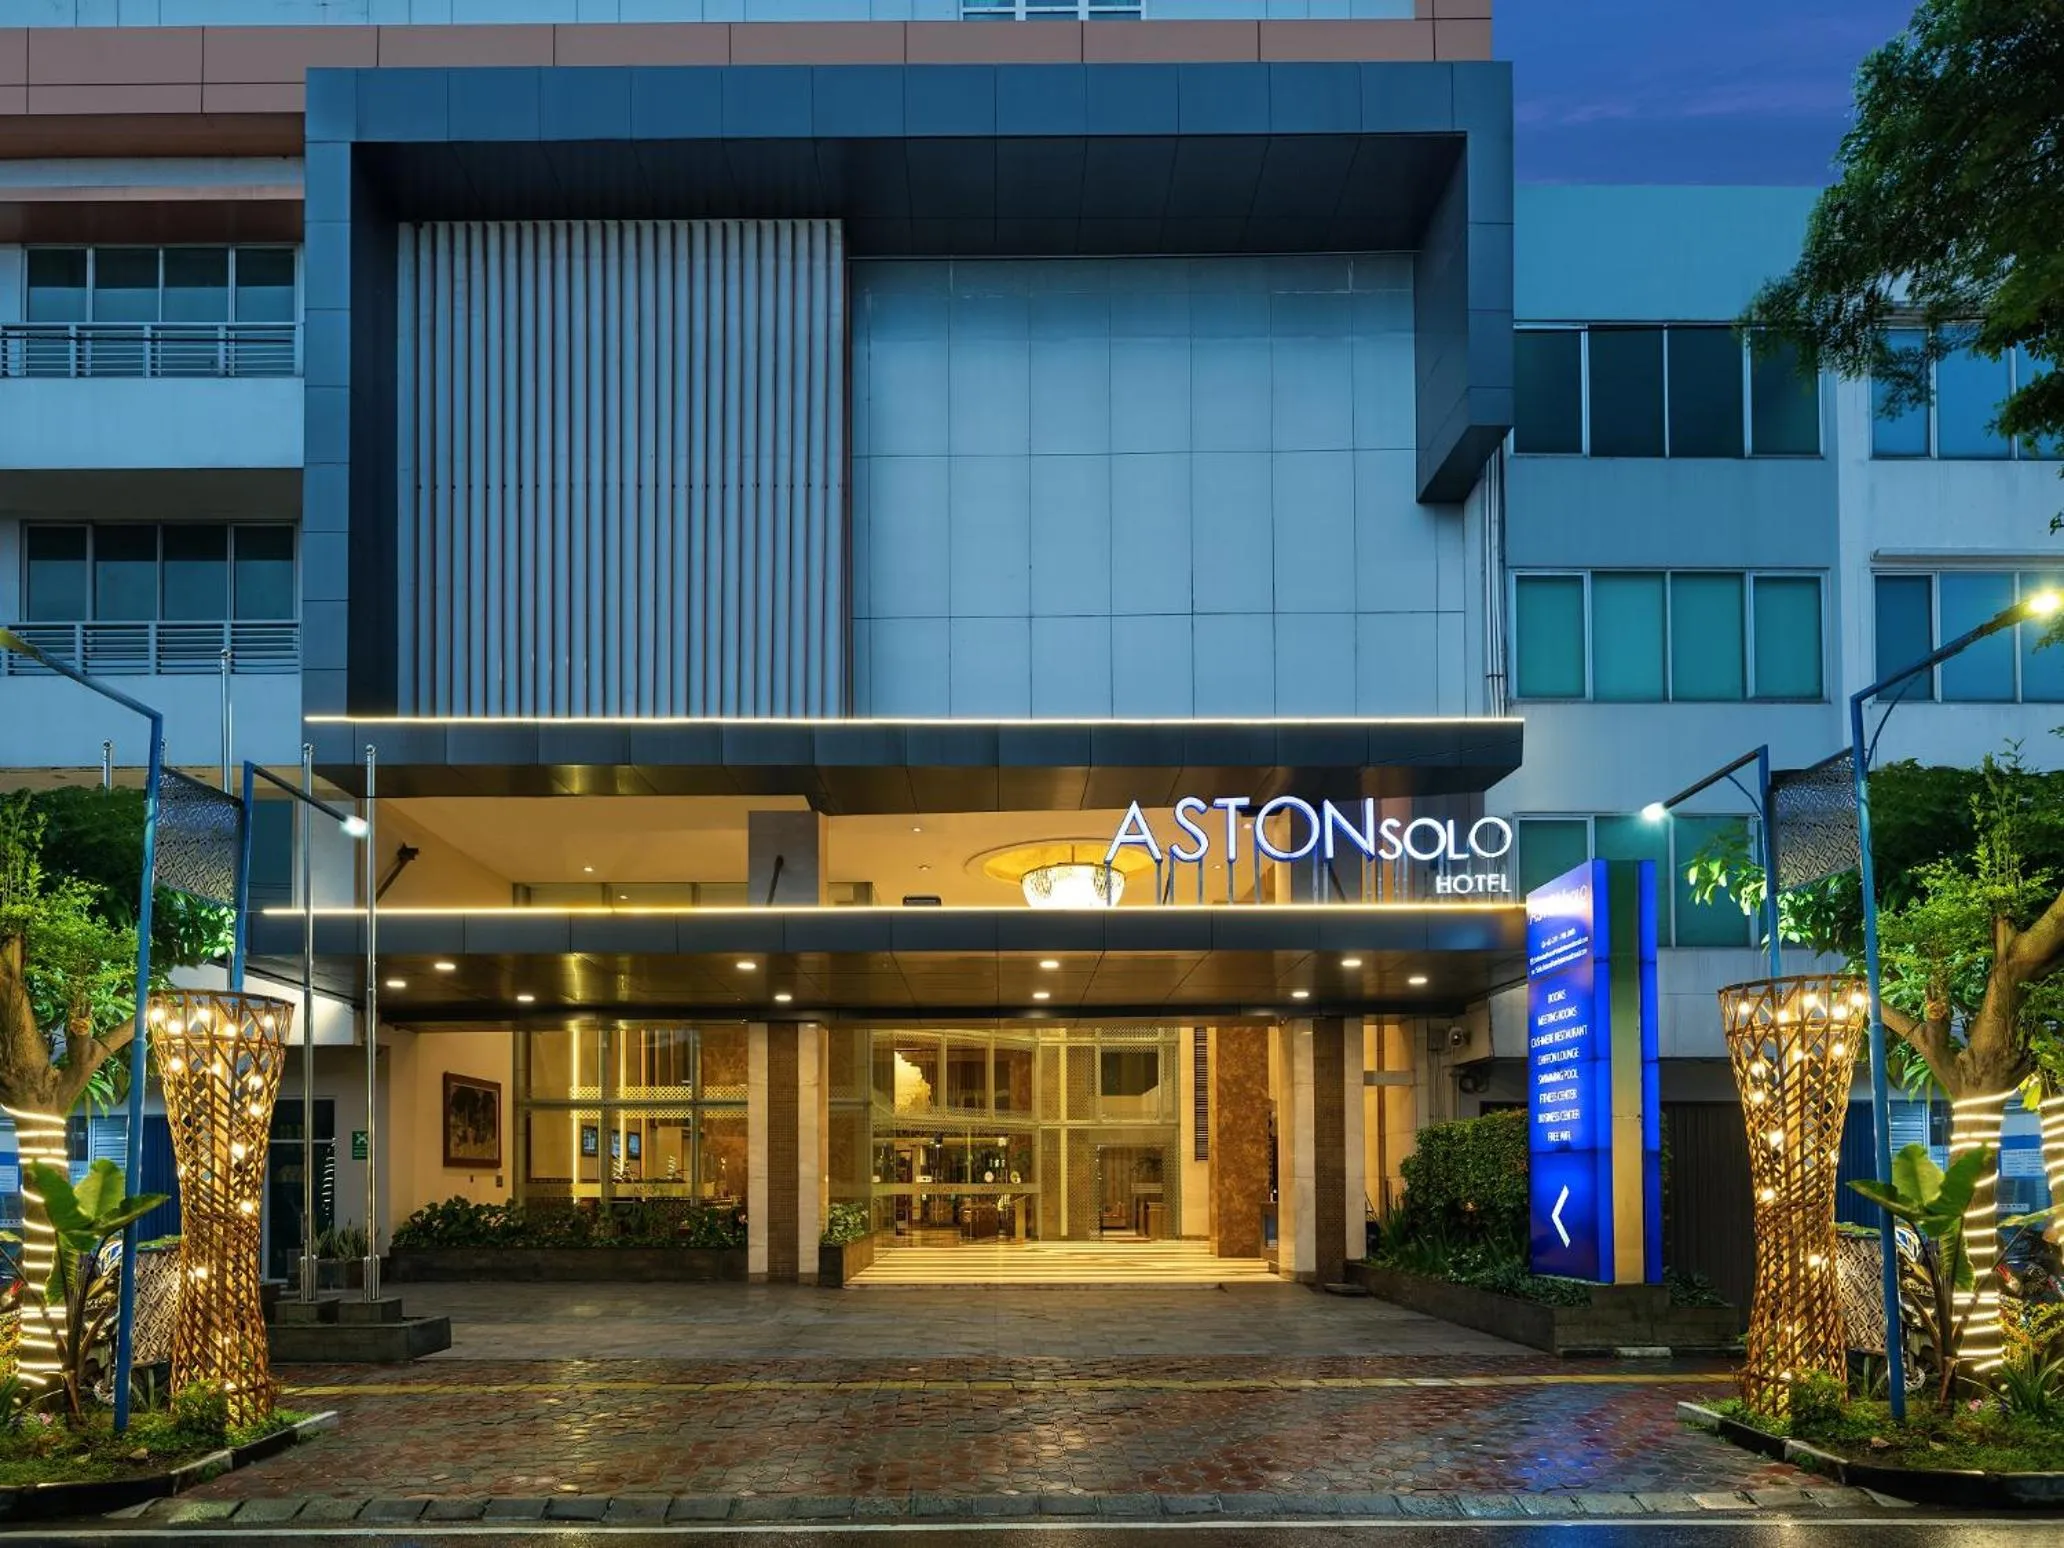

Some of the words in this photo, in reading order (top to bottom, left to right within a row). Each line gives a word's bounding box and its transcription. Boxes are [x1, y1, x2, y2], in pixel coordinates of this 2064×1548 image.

[1104, 796, 1375, 862] ASTON
[1378, 816, 1512, 861] SOLO
[1435, 873, 1512, 894] HOTEL
[1547, 989, 1566, 1003] ROOMS
[1538, 1011, 1558, 1025] MEETING
[1558, 1006, 1577, 1020] ROOMS
[1554, 1025, 1588, 1043] RESTAURANT
[1557, 1047, 1580, 1061] LOUNGE
[1538, 1071, 1563, 1084] SWIMMING
[1564, 1069, 1579, 1079] POOL
